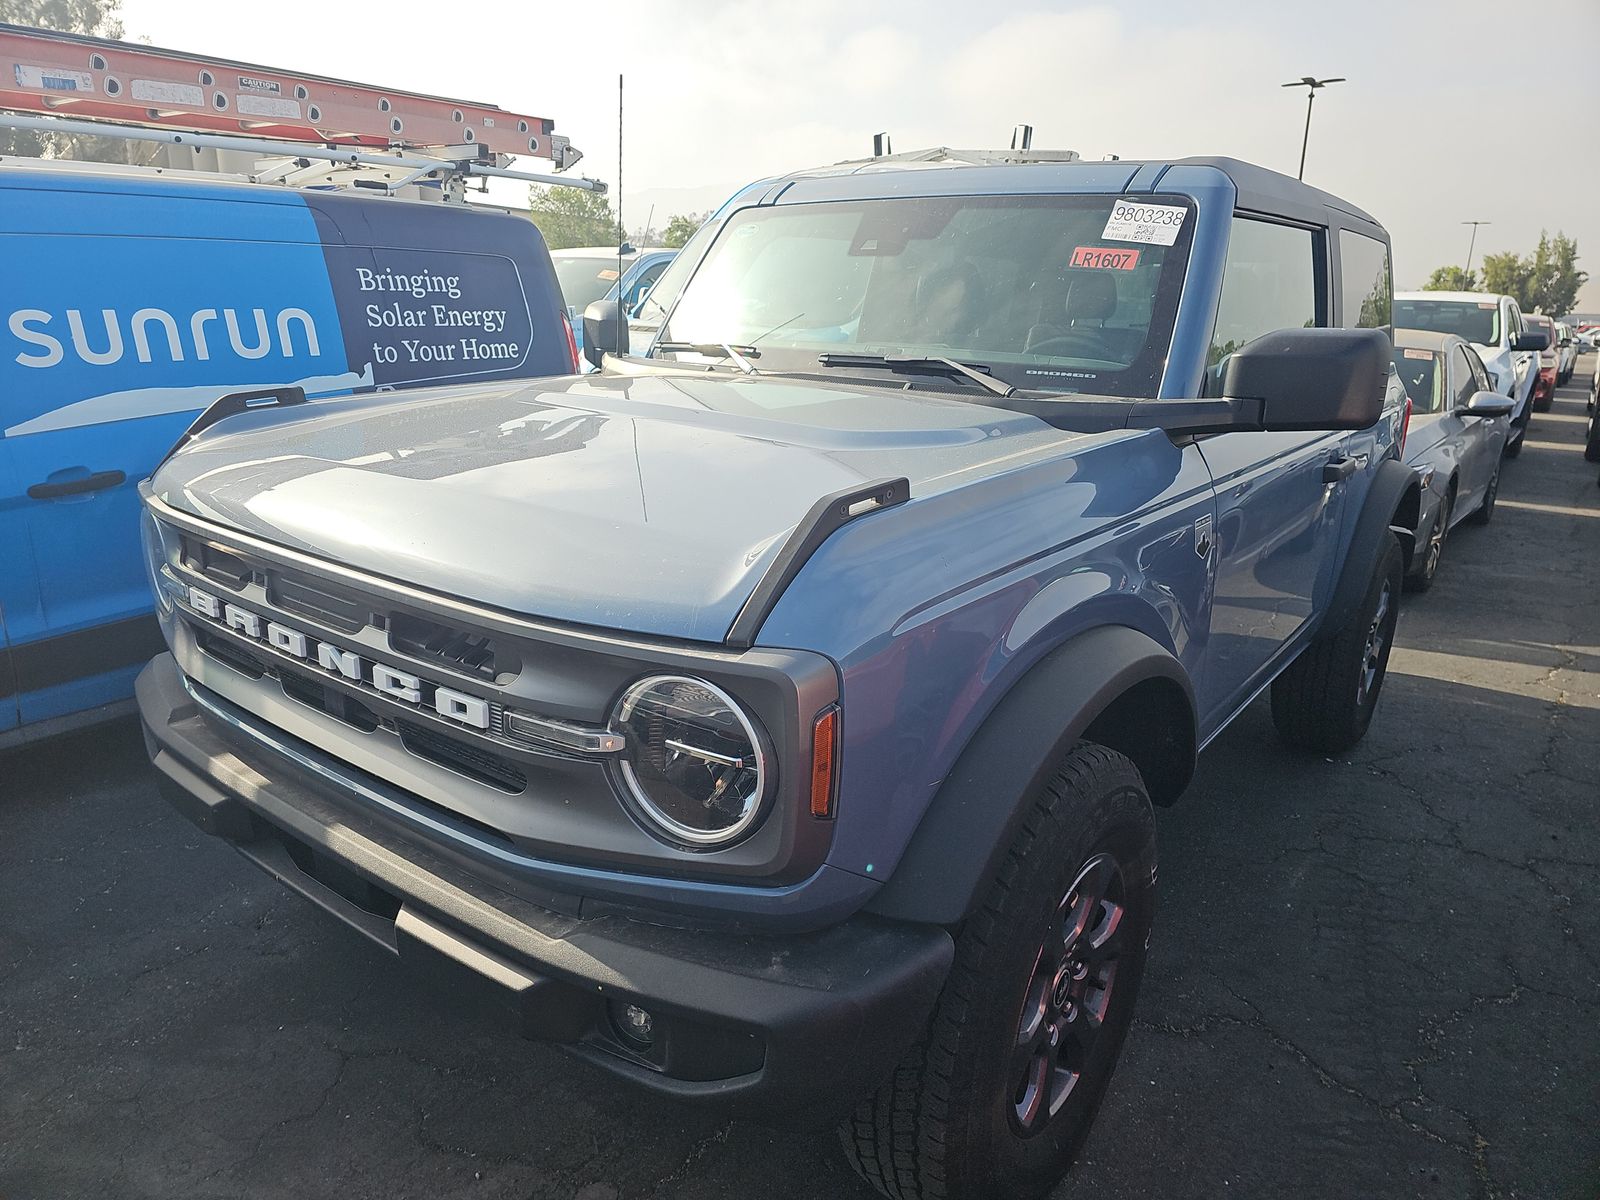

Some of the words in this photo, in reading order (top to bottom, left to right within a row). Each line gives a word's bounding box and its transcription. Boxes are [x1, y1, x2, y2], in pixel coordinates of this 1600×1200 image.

[242, 78, 277, 89] CAUTION
[1114, 206, 1185, 226] 9803238
[1072, 251, 1132, 269] LR1607
[356, 267, 462, 299] Bringing
[366, 302, 427, 328] Solar
[431, 304, 507, 332] Energy
[8, 307, 321, 368] sunrun
[373, 341, 398, 364] to
[401, 339, 456, 362] Your
[460, 338, 519, 360] Home
[1025, 369, 1097, 379] BRONCO
[189, 586, 490, 729] BRONCO
